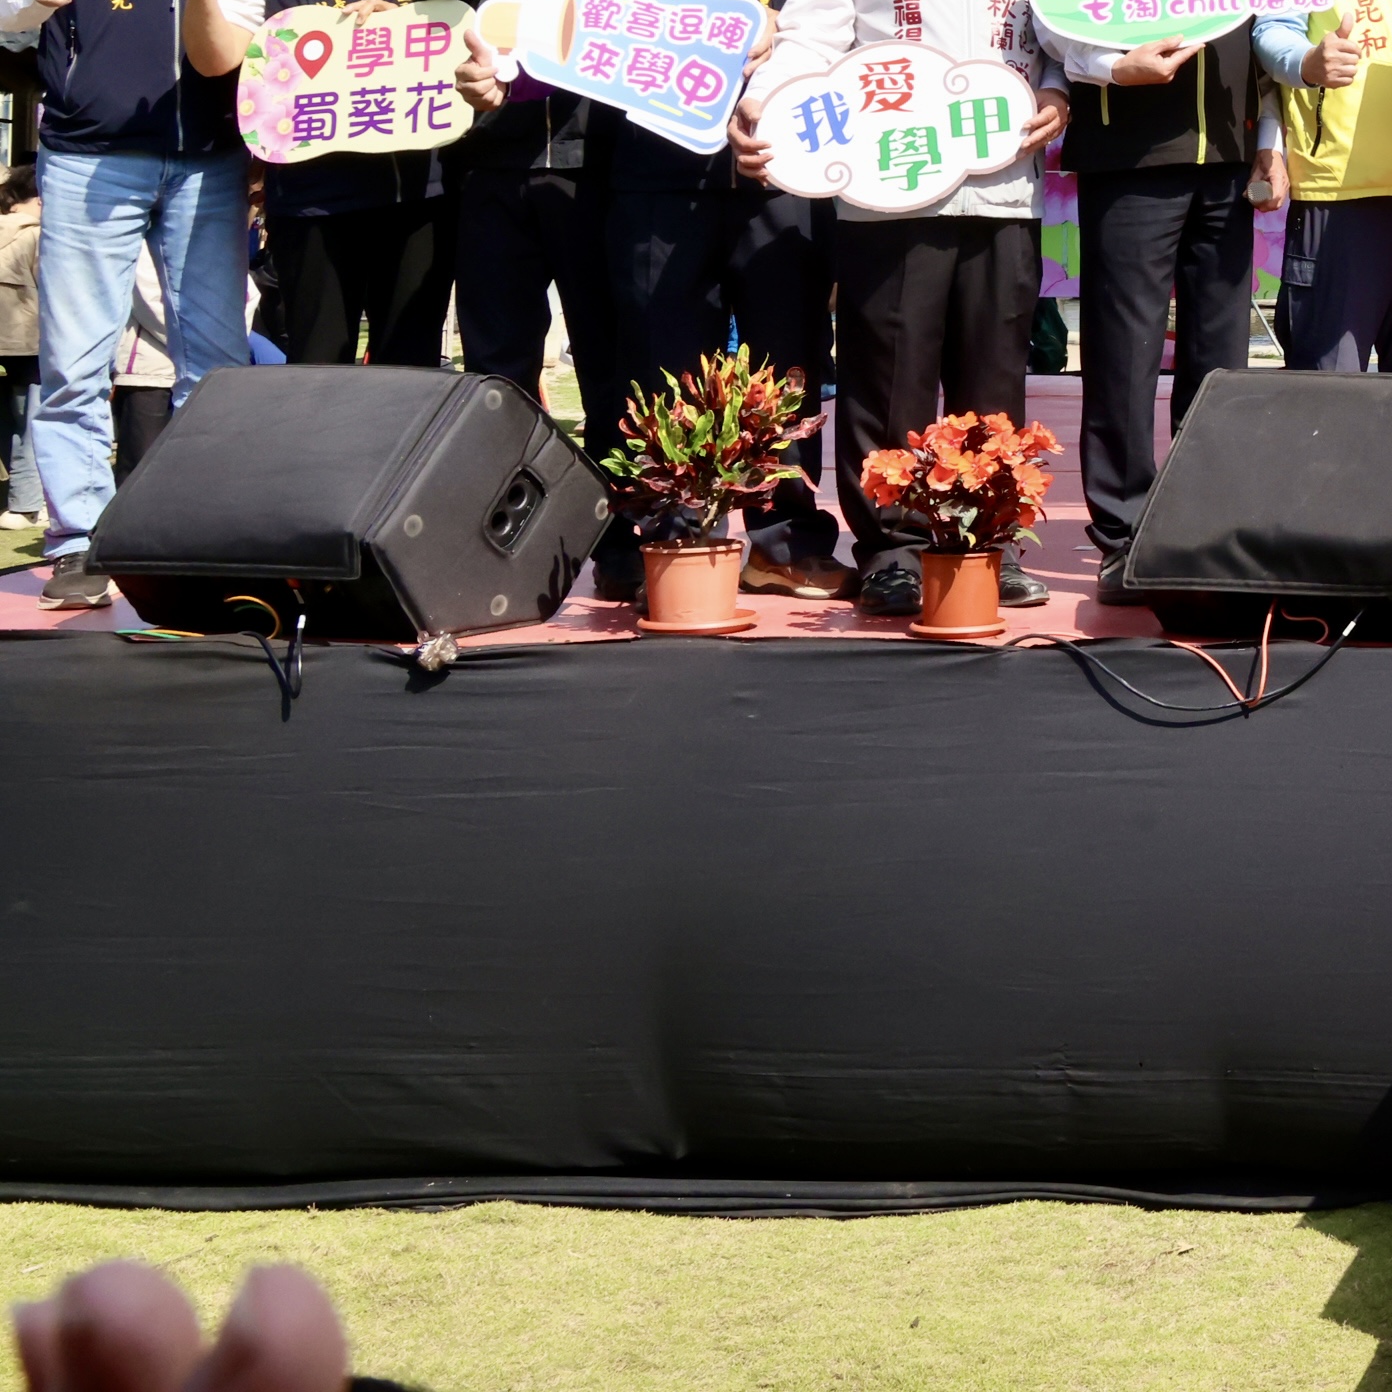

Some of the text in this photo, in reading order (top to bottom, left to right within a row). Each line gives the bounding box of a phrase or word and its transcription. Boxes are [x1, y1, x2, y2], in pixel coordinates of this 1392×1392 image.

[346, 21, 453, 78] 學甲
[580, 41, 724, 107] 來學甲
[292, 80, 454, 142] 蜀葵花
